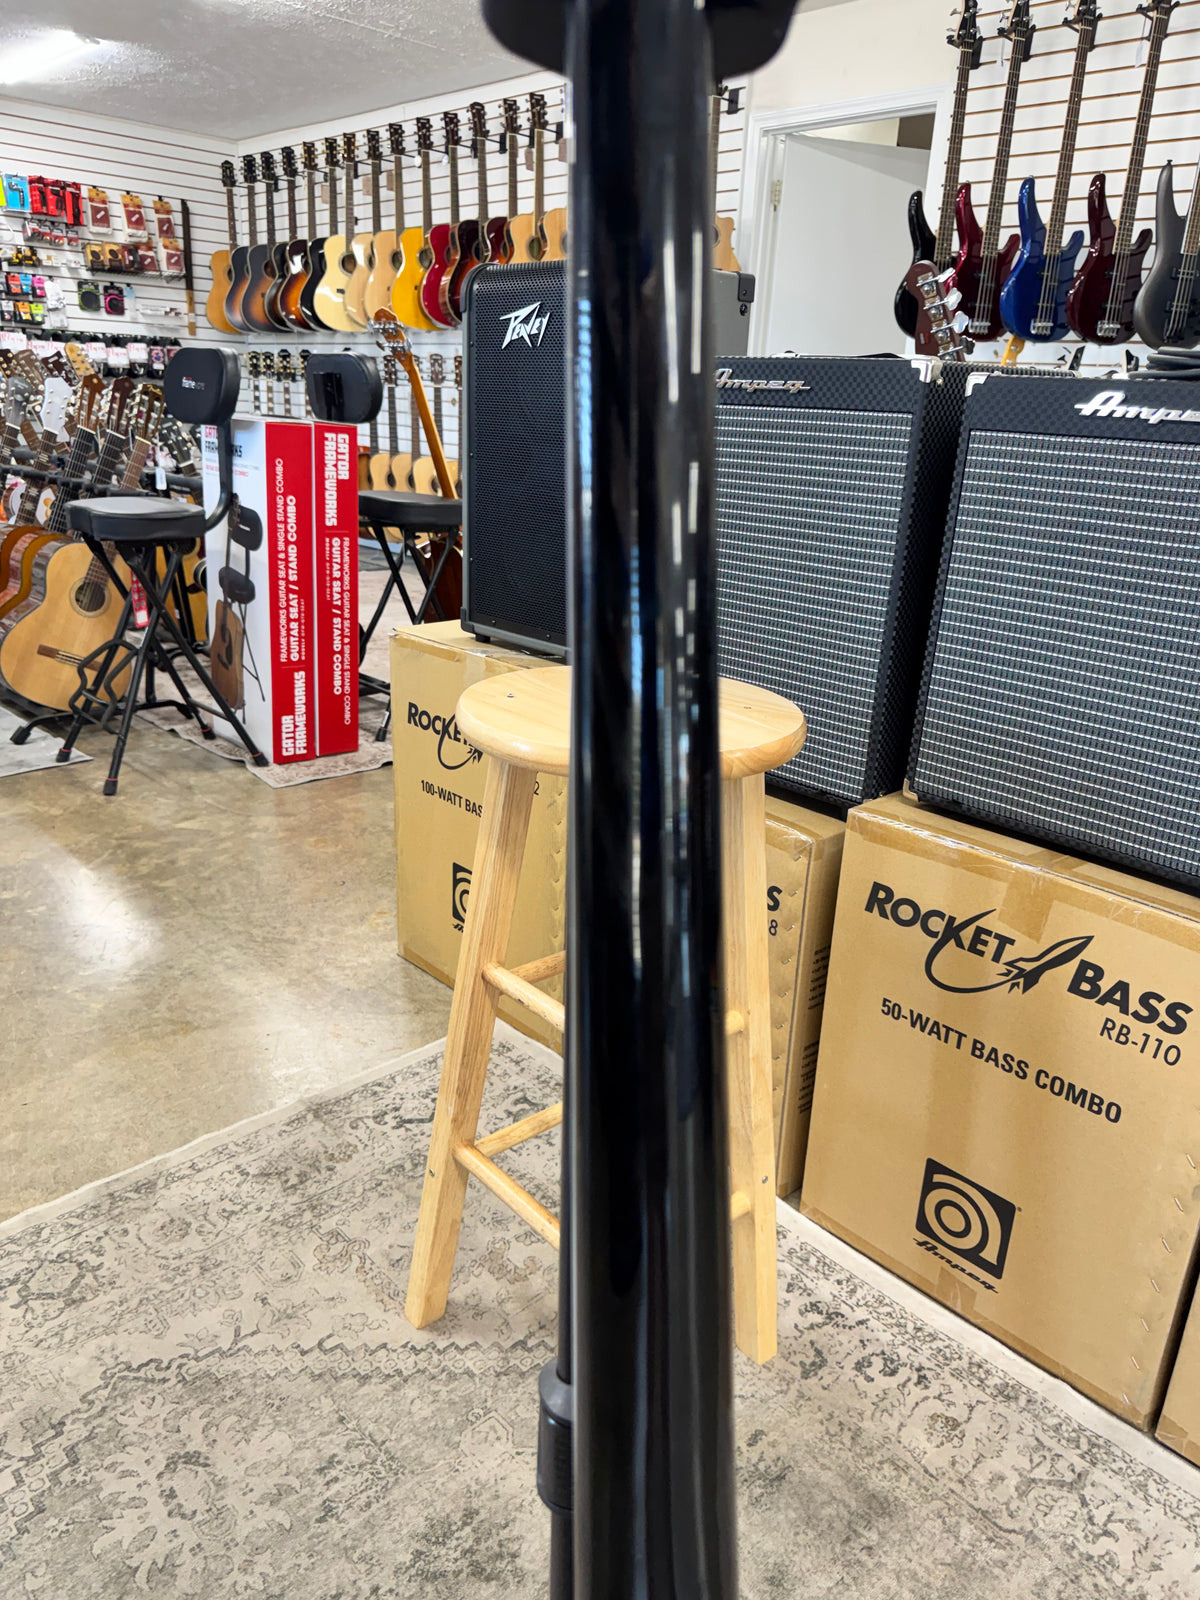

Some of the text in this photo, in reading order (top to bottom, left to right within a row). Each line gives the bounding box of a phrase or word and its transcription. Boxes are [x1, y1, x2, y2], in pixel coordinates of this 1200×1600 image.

[714, 368, 811, 394] Ampeg
[275, 458, 284, 493] COMBO
[337, 433, 350, 480] GATOR
[324, 432, 338, 527] FRAMEWORKS
[276, 495, 285, 521] STAND
[286, 495, 297, 542] COMBO
[277, 523, 286, 551] SINGLE
[277, 561, 286, 578] SEAT
[287, 544, 298, 581] STAND
[332, 537, 341, 578] GUITAR
[278, 580, 287, 608] GUITAR
[288, 593, 299, 619] SEAT
[332, 580, 341, 606] SEAT
[343, 591, 351, 618] GUITAR
[280, 609, 288, 662] FRAMEWORKS
[289, 621, 300, 661] GUITAR
[332, 617, 342, 652] STAND
[343, 619, 351, 636] SEAT
[333, 654, 342, 695] COMBO
[343, 645, 351, 670] SINGLE
[294, 670, 307, 755] FRAMEWORKS
[408, 701, 468, 746] ROCKE
[281, 715, 295, 757] GATOR
[421, 779, 463, 808] 100-WATT
[864, 881, 1194, 1035] ROCKET BASS
[881, 997, 1122, 1123] 50-WATT BASS COMBO
[1099, 1017, 1181, 1066] RB-110
[913, 1238, 998, 1293] Ampeg
